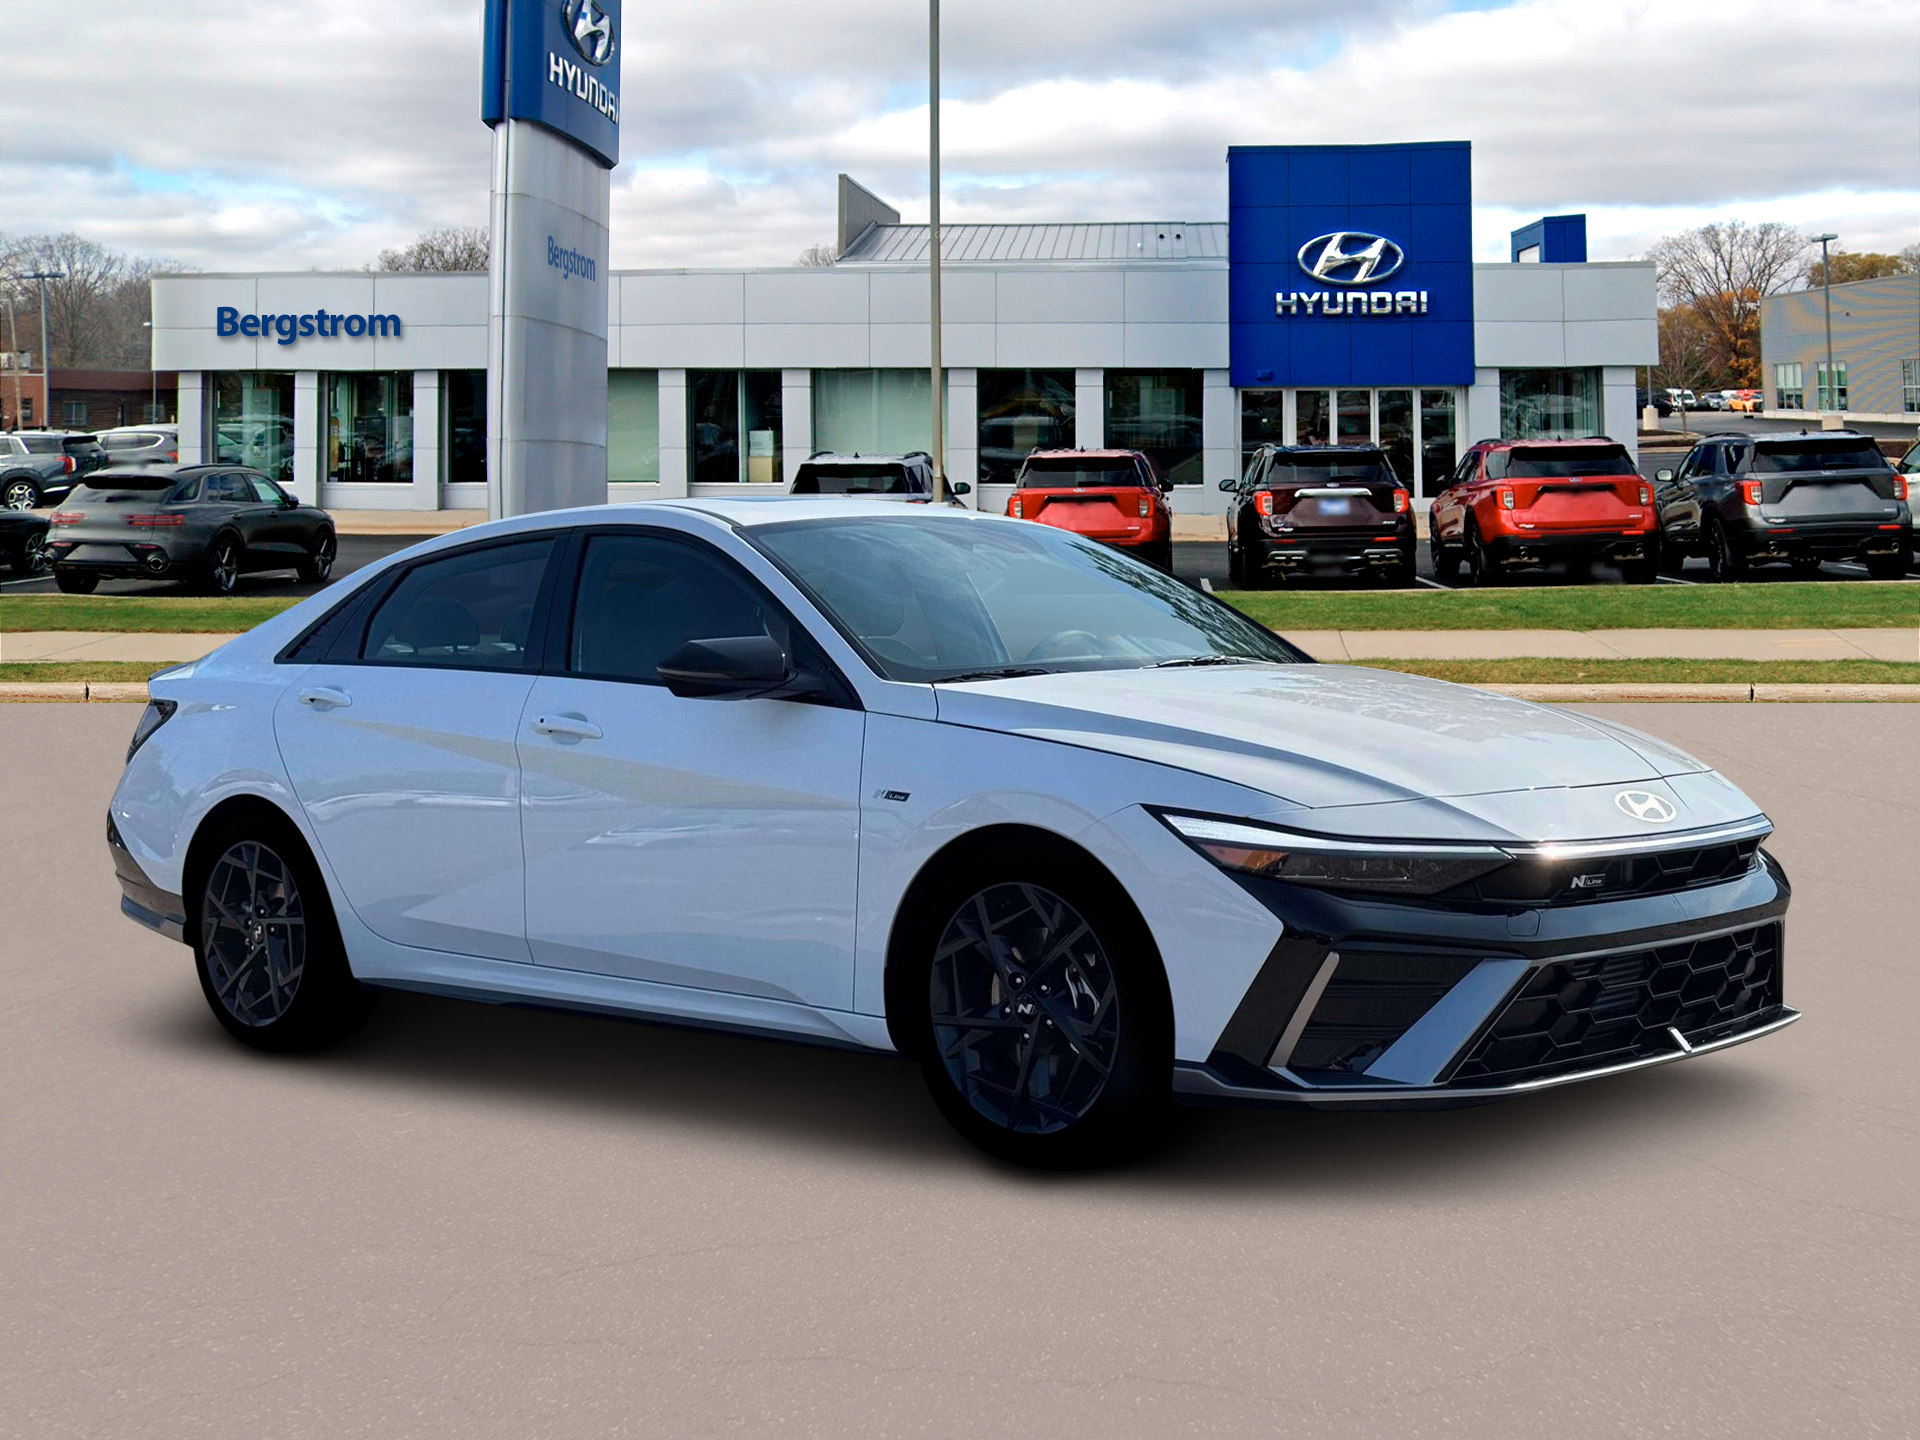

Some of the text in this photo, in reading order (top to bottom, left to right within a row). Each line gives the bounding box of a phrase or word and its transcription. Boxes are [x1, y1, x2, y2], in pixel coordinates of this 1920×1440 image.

[549, 52, 619, 124] HYUNDAI
[548, 235, 596, 282] Bergstrom
[1275, 291, 1428, 315] HYUNDAI
[217, 306, 401, 346] Bergstrom
